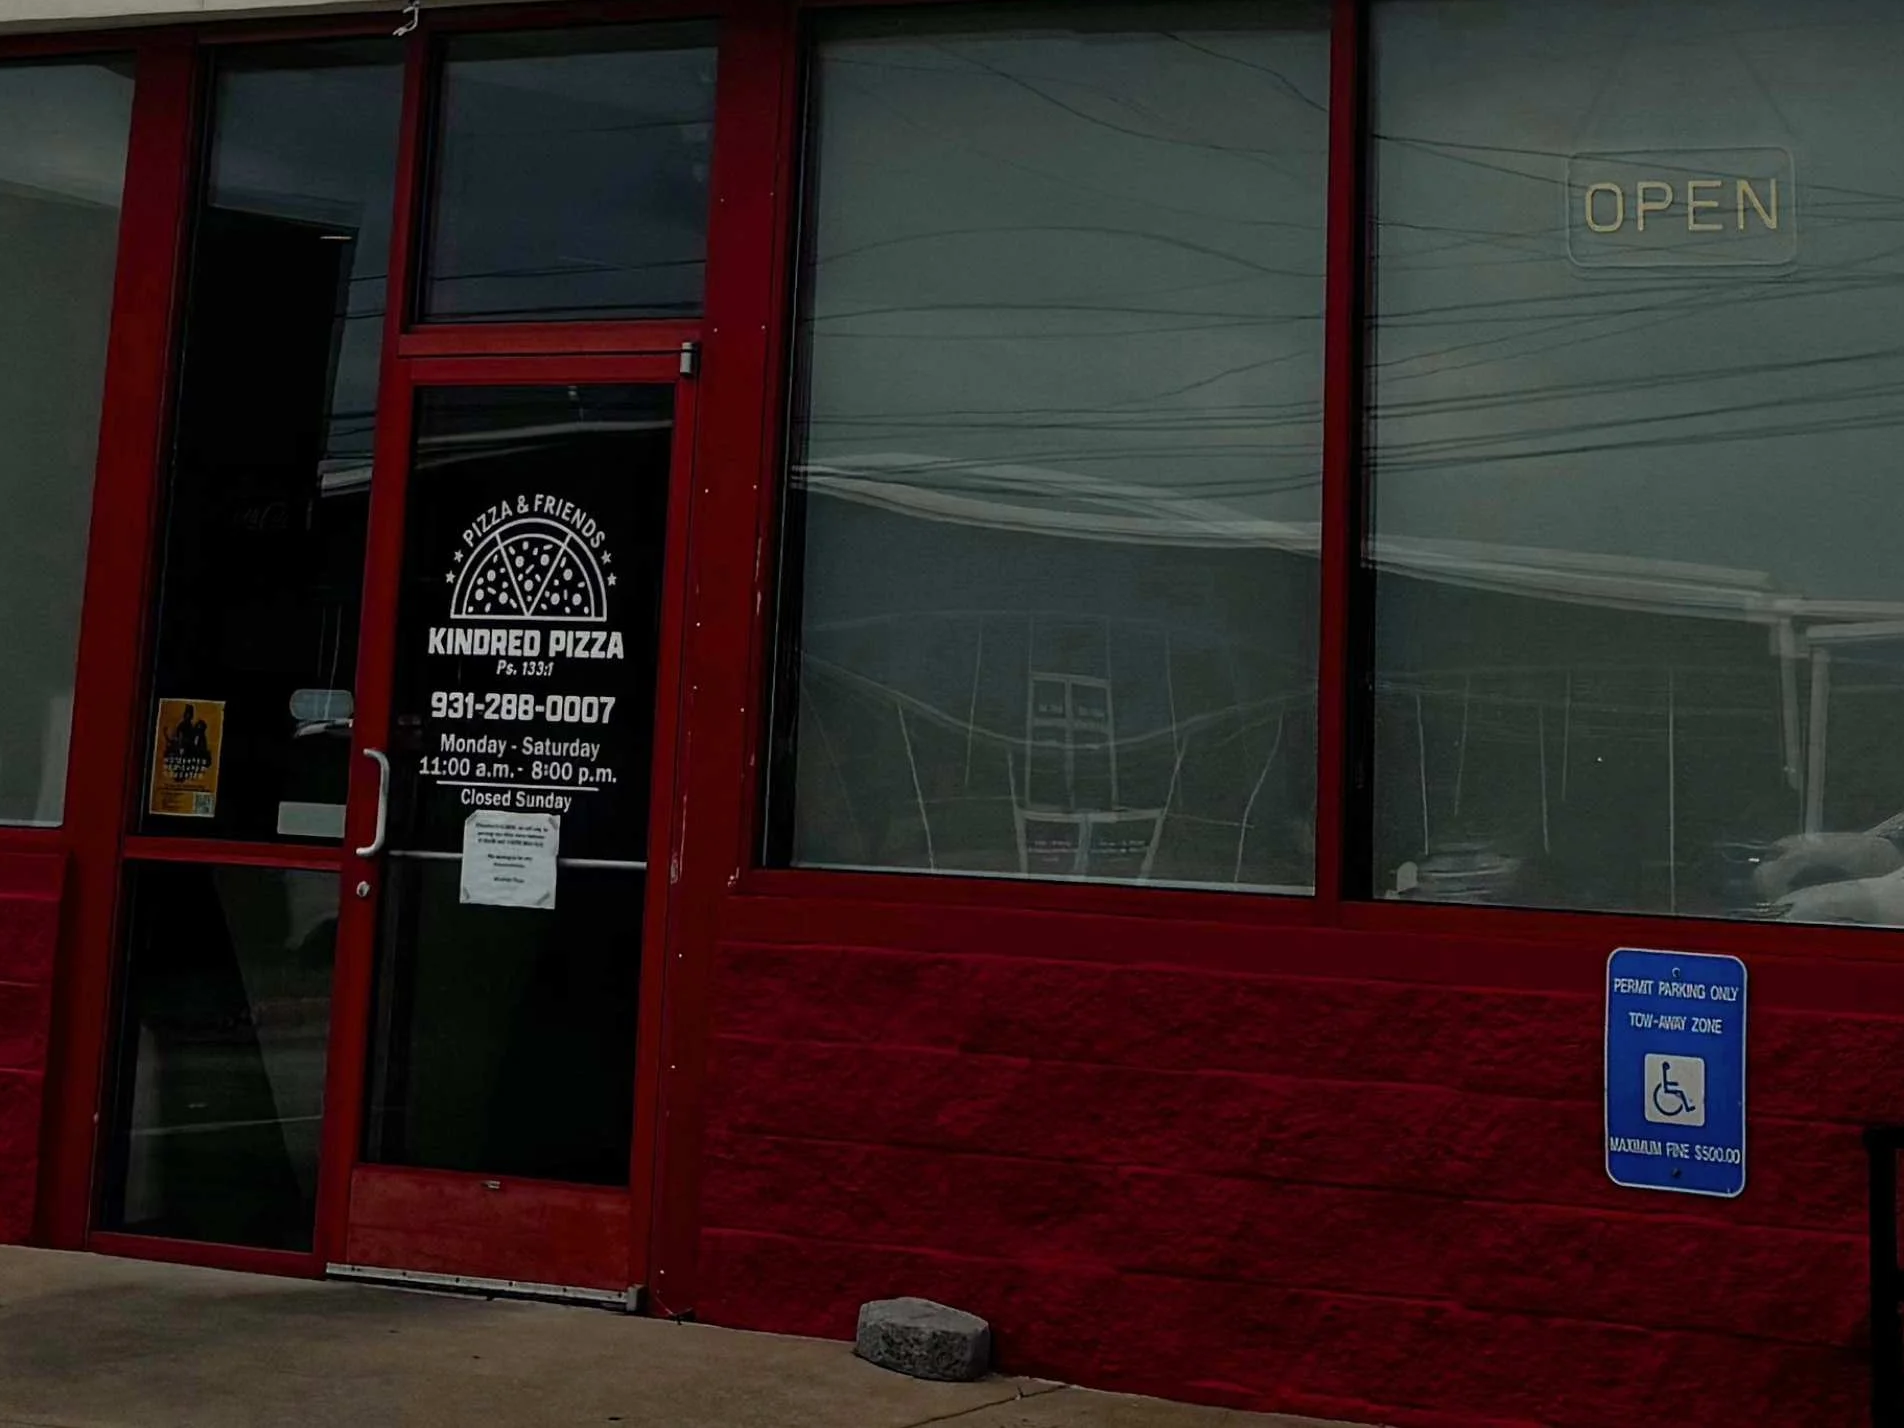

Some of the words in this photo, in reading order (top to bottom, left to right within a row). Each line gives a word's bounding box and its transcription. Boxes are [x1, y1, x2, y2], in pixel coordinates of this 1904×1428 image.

[1584, 177, 1778, 233] OPEN
[462, 499, 513, 547] PIZZA
[516, 494, 529, 514] &
[533, 493, 606, 548] FRIENDS
[427, 626, 541, 657] KINDRED
[548, 629, 625, 660] PIZZA
[496, 659, 517, 675] Ps.
[522, 660, 554, 676] 133:1
[430, 691, 616, 724] 931-288-0007
[440, 733, 507, 758] Monday
[521, 736, 601, 762] Saturday
[419, 755, 471, 776] 11:00
[531, 760, 573, 781] 8:00
[578, 766, 617, 785] p.m.
[460, 788, 512, 807] Closed
[515, 790, 573, 813] Sunday
[1613, 977, 1655, 995] PERMIT
[1658, 980, 1706, 1000] PARKING
[1710, 985, 1739, 1002] ONLY
[1628, 1011, 1687, 1031] TOW-AWAY
[1690, 1016, 1723, 1035] ZONE
[1666, 1141, 1690, 1159] FINE
